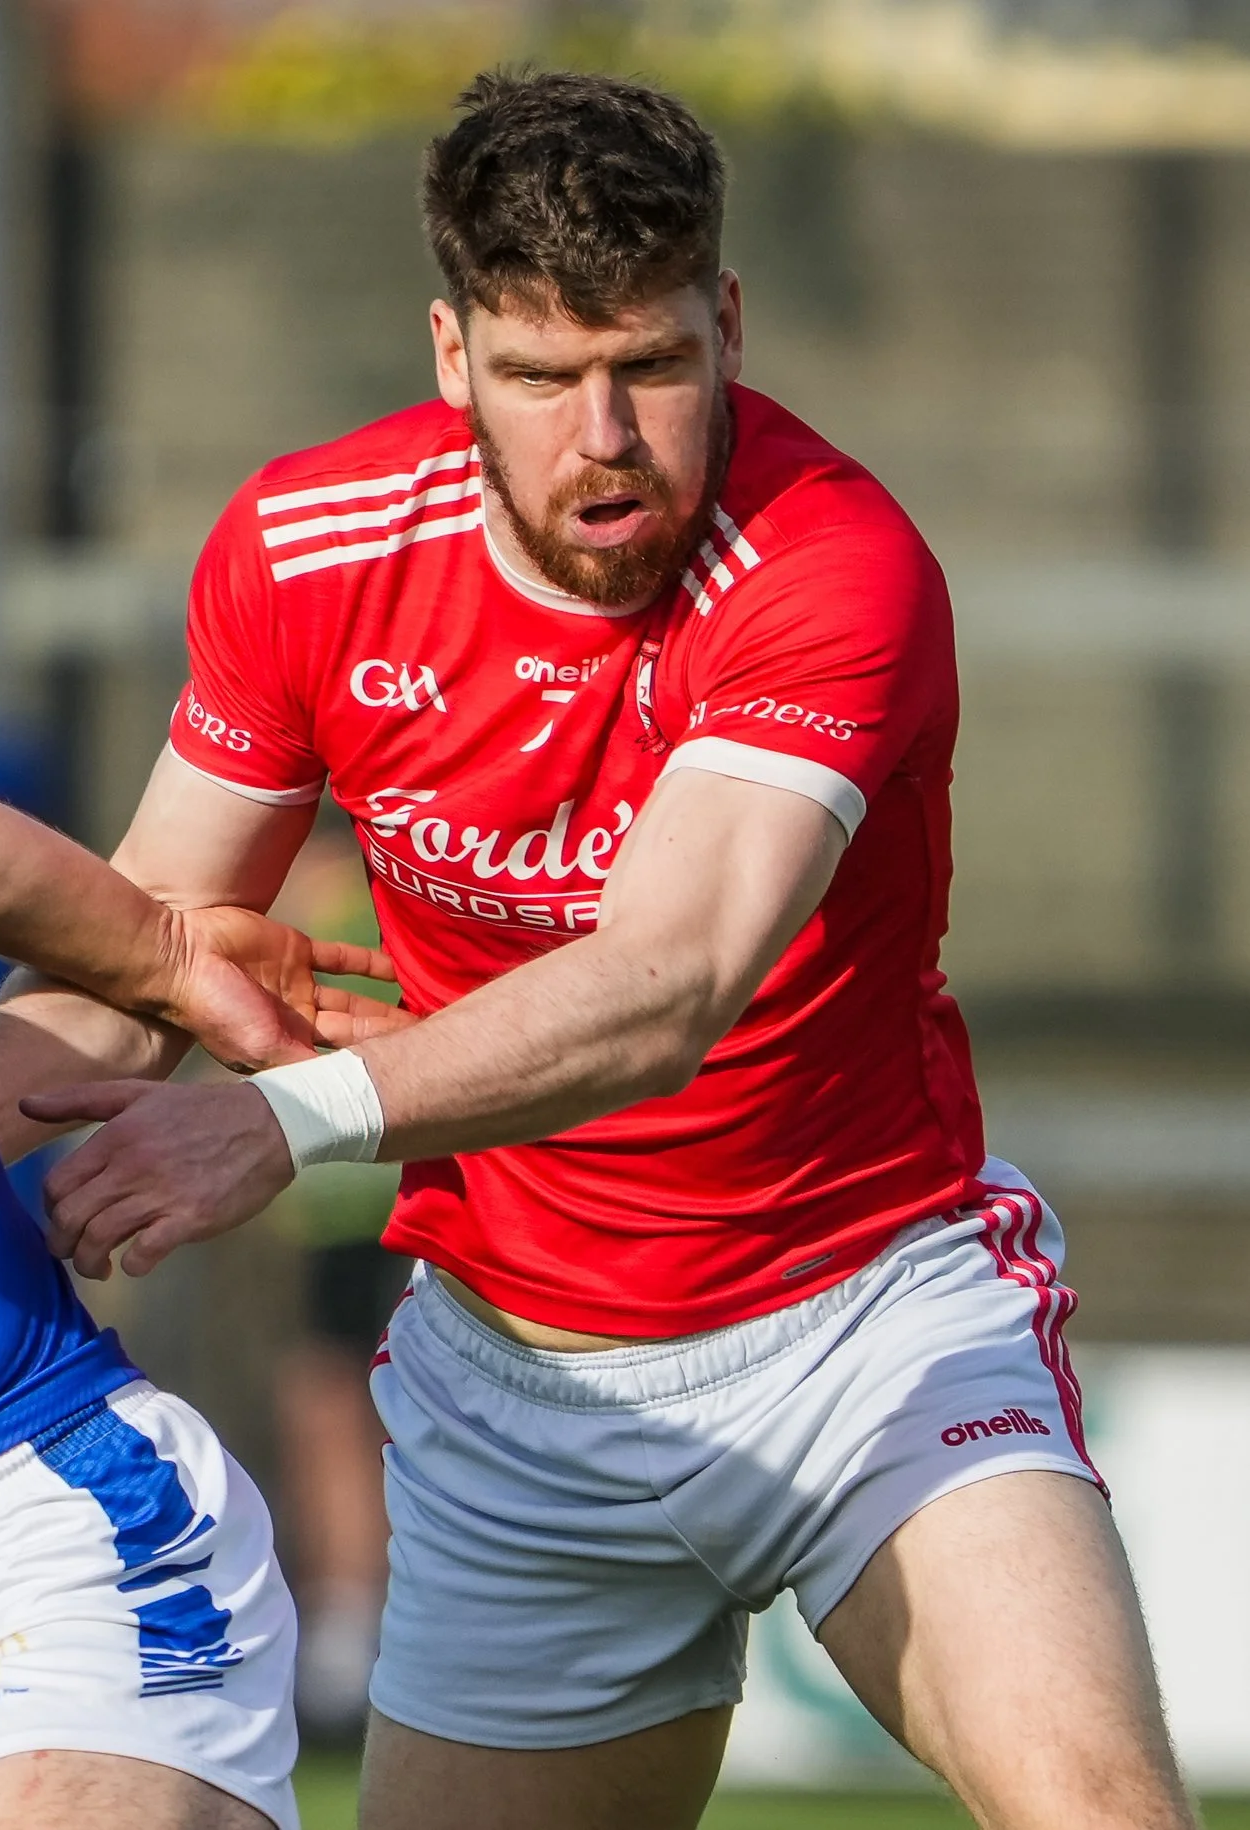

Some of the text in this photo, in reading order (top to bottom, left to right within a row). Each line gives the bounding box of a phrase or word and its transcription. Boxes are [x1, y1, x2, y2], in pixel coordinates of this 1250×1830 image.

[350, 658, 448, 712] GAA
[366, 787, 634, 880] Forde'
[367, 839, 600, 930] EUROSP
